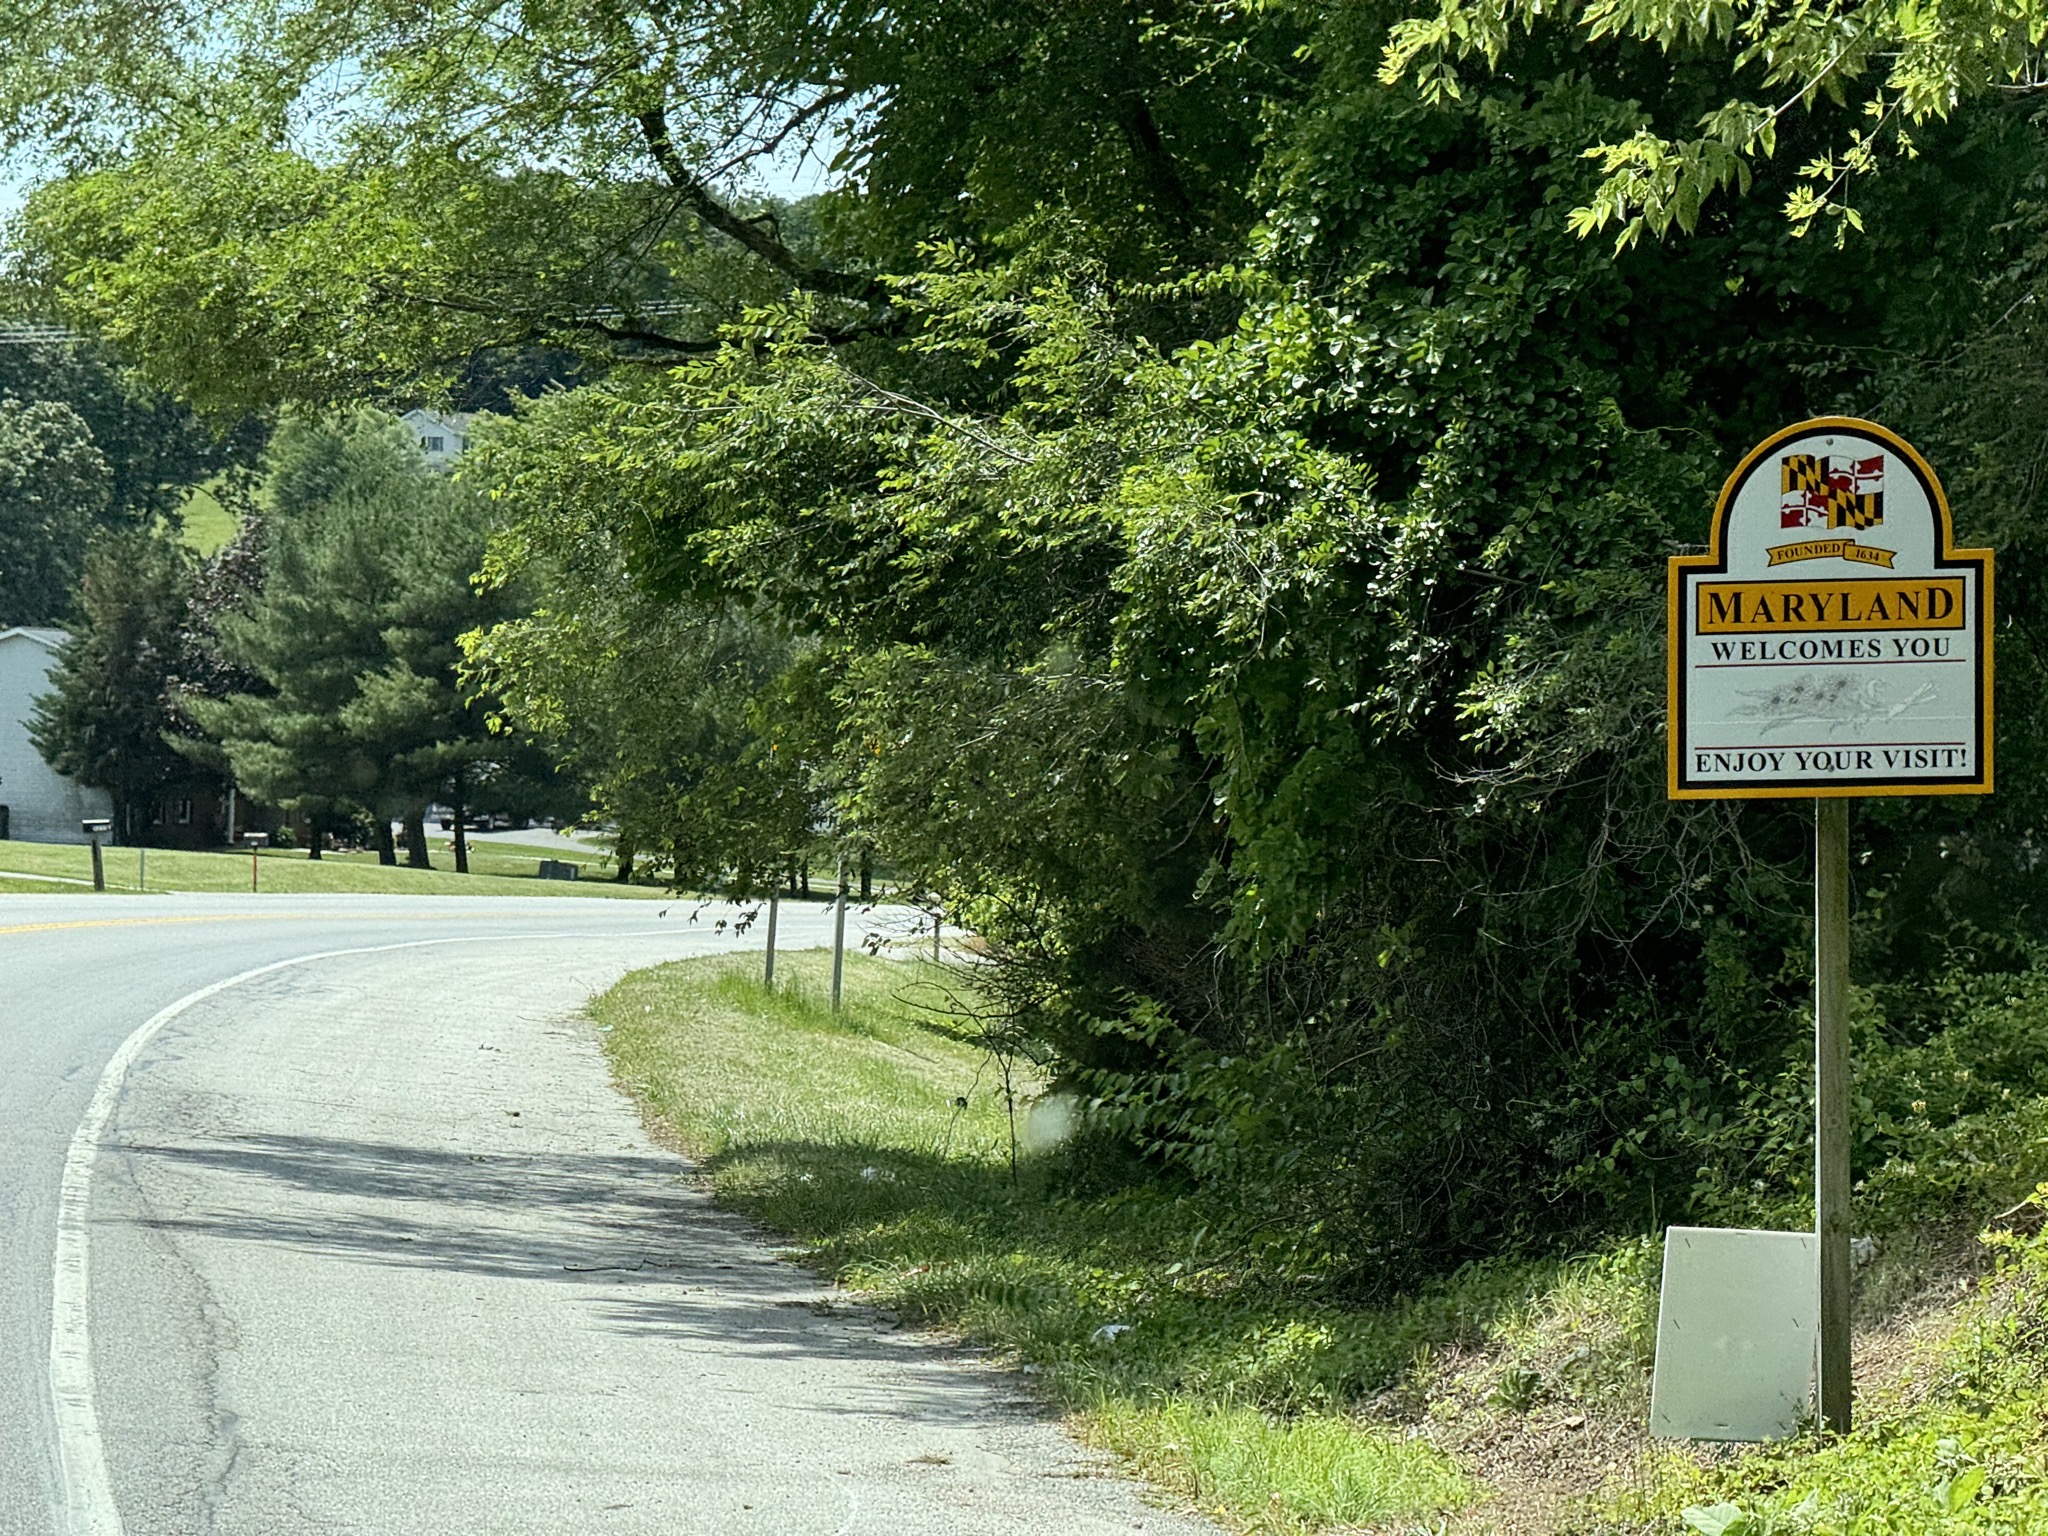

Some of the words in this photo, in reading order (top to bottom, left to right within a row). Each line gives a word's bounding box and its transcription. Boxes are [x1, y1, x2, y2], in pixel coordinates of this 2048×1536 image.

[1777, 542, 1841, 561] FOUNDED
[1855, 549, 1880, 562] 1634
[1707, 587, 1954, 625] MARYLAND
[1711, 639, 1882, 661] WELCOMES
[1892, 637, 1951, 657] YOU
[1695, 752, 1785, 773] ENJOY
[1796, 751, 1873, 771] YOUR
[1883, 749, 1967, 770] VISIT!
